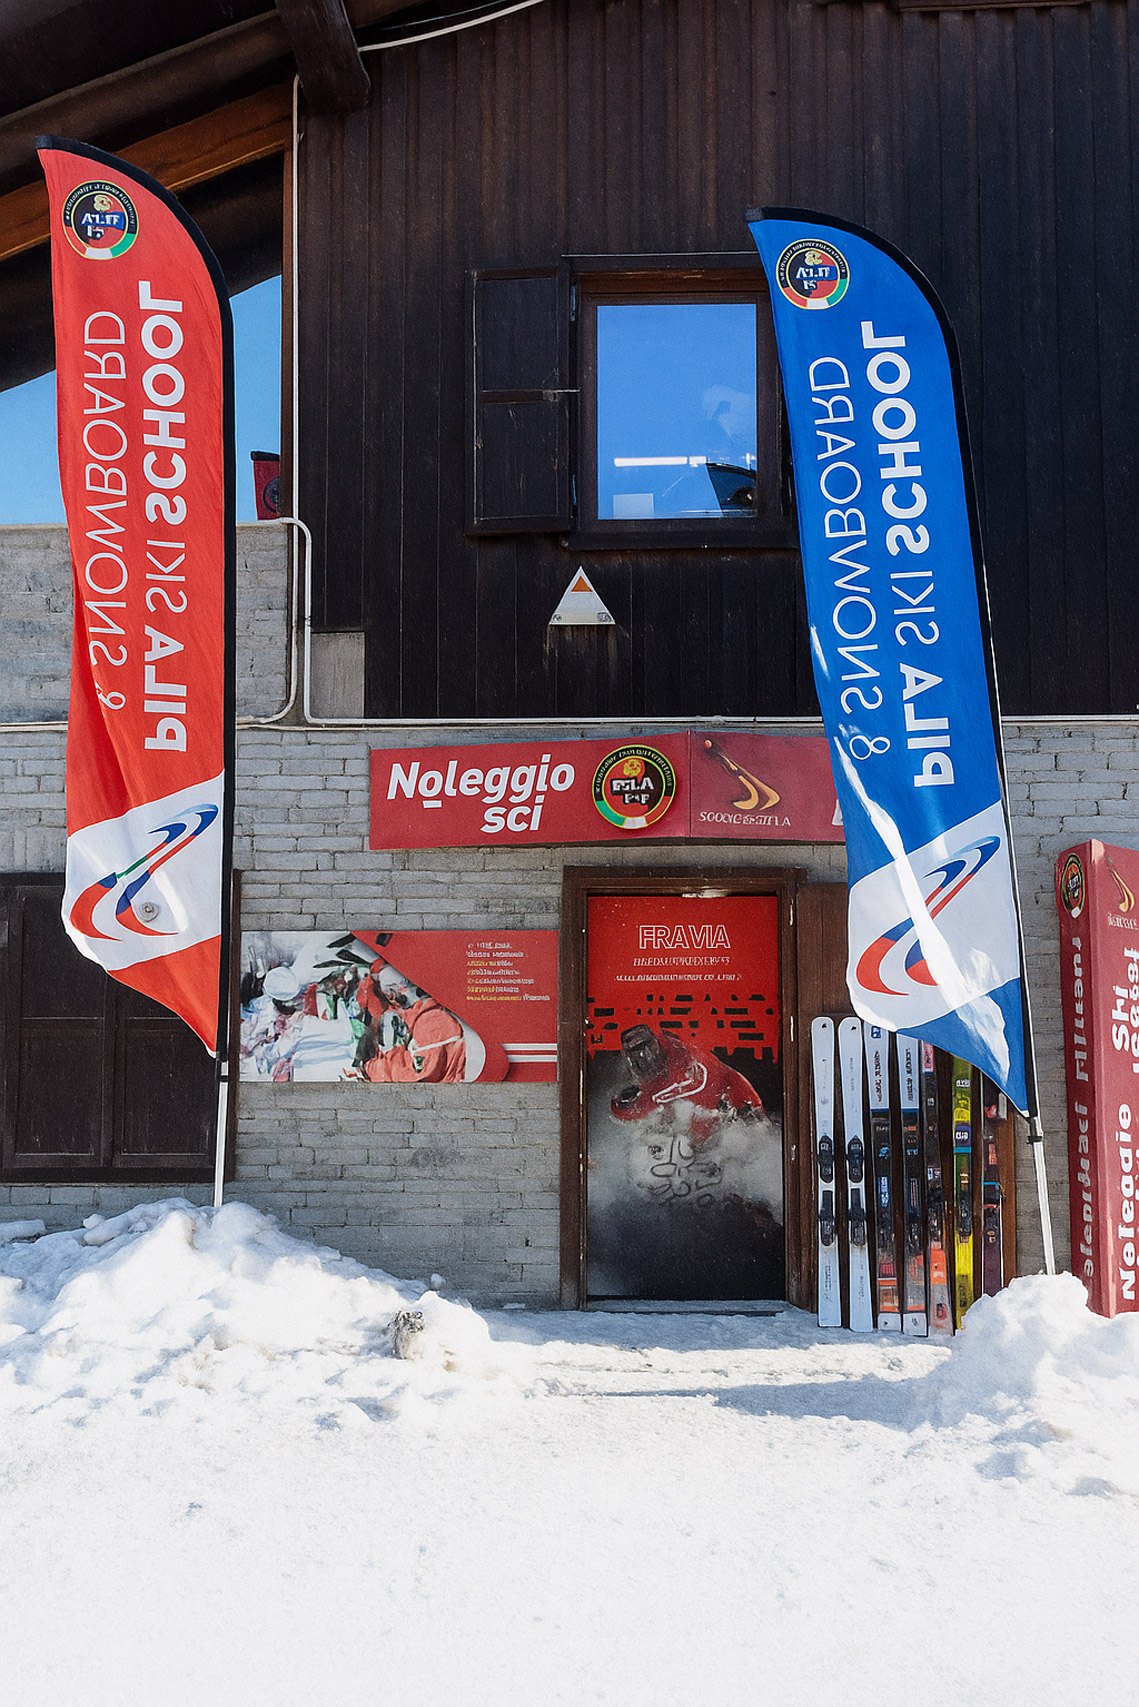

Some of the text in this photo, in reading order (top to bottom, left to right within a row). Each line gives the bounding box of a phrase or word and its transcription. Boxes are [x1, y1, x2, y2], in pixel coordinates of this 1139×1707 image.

[387, 754, 575, 804] Noleggio
[480, 794, 545, 833] sci
[639, 925, 731, 949] FRAVIA
